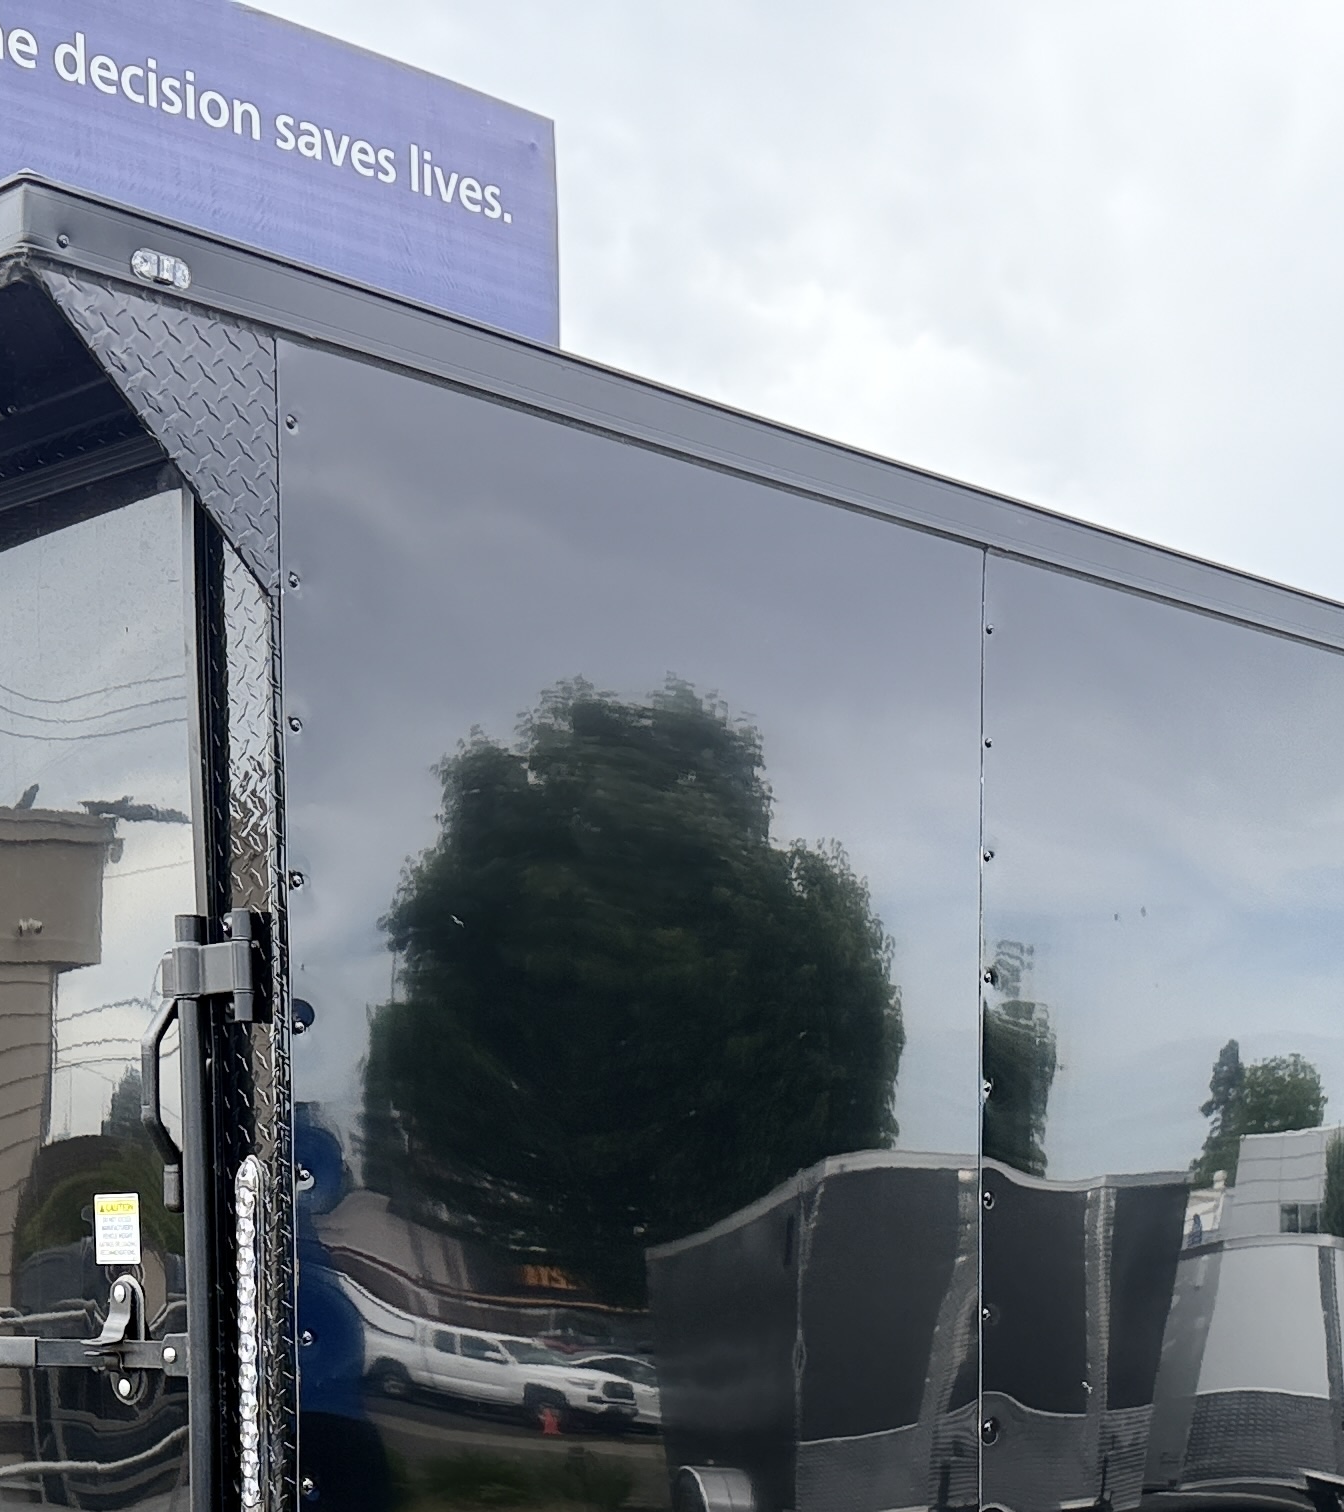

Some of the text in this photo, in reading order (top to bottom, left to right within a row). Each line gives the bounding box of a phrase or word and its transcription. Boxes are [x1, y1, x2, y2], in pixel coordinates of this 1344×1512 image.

[55, 33, 260, 140] decision
[276, 115, 396, 182] saves
[411, 144, 512, 223] lives.
